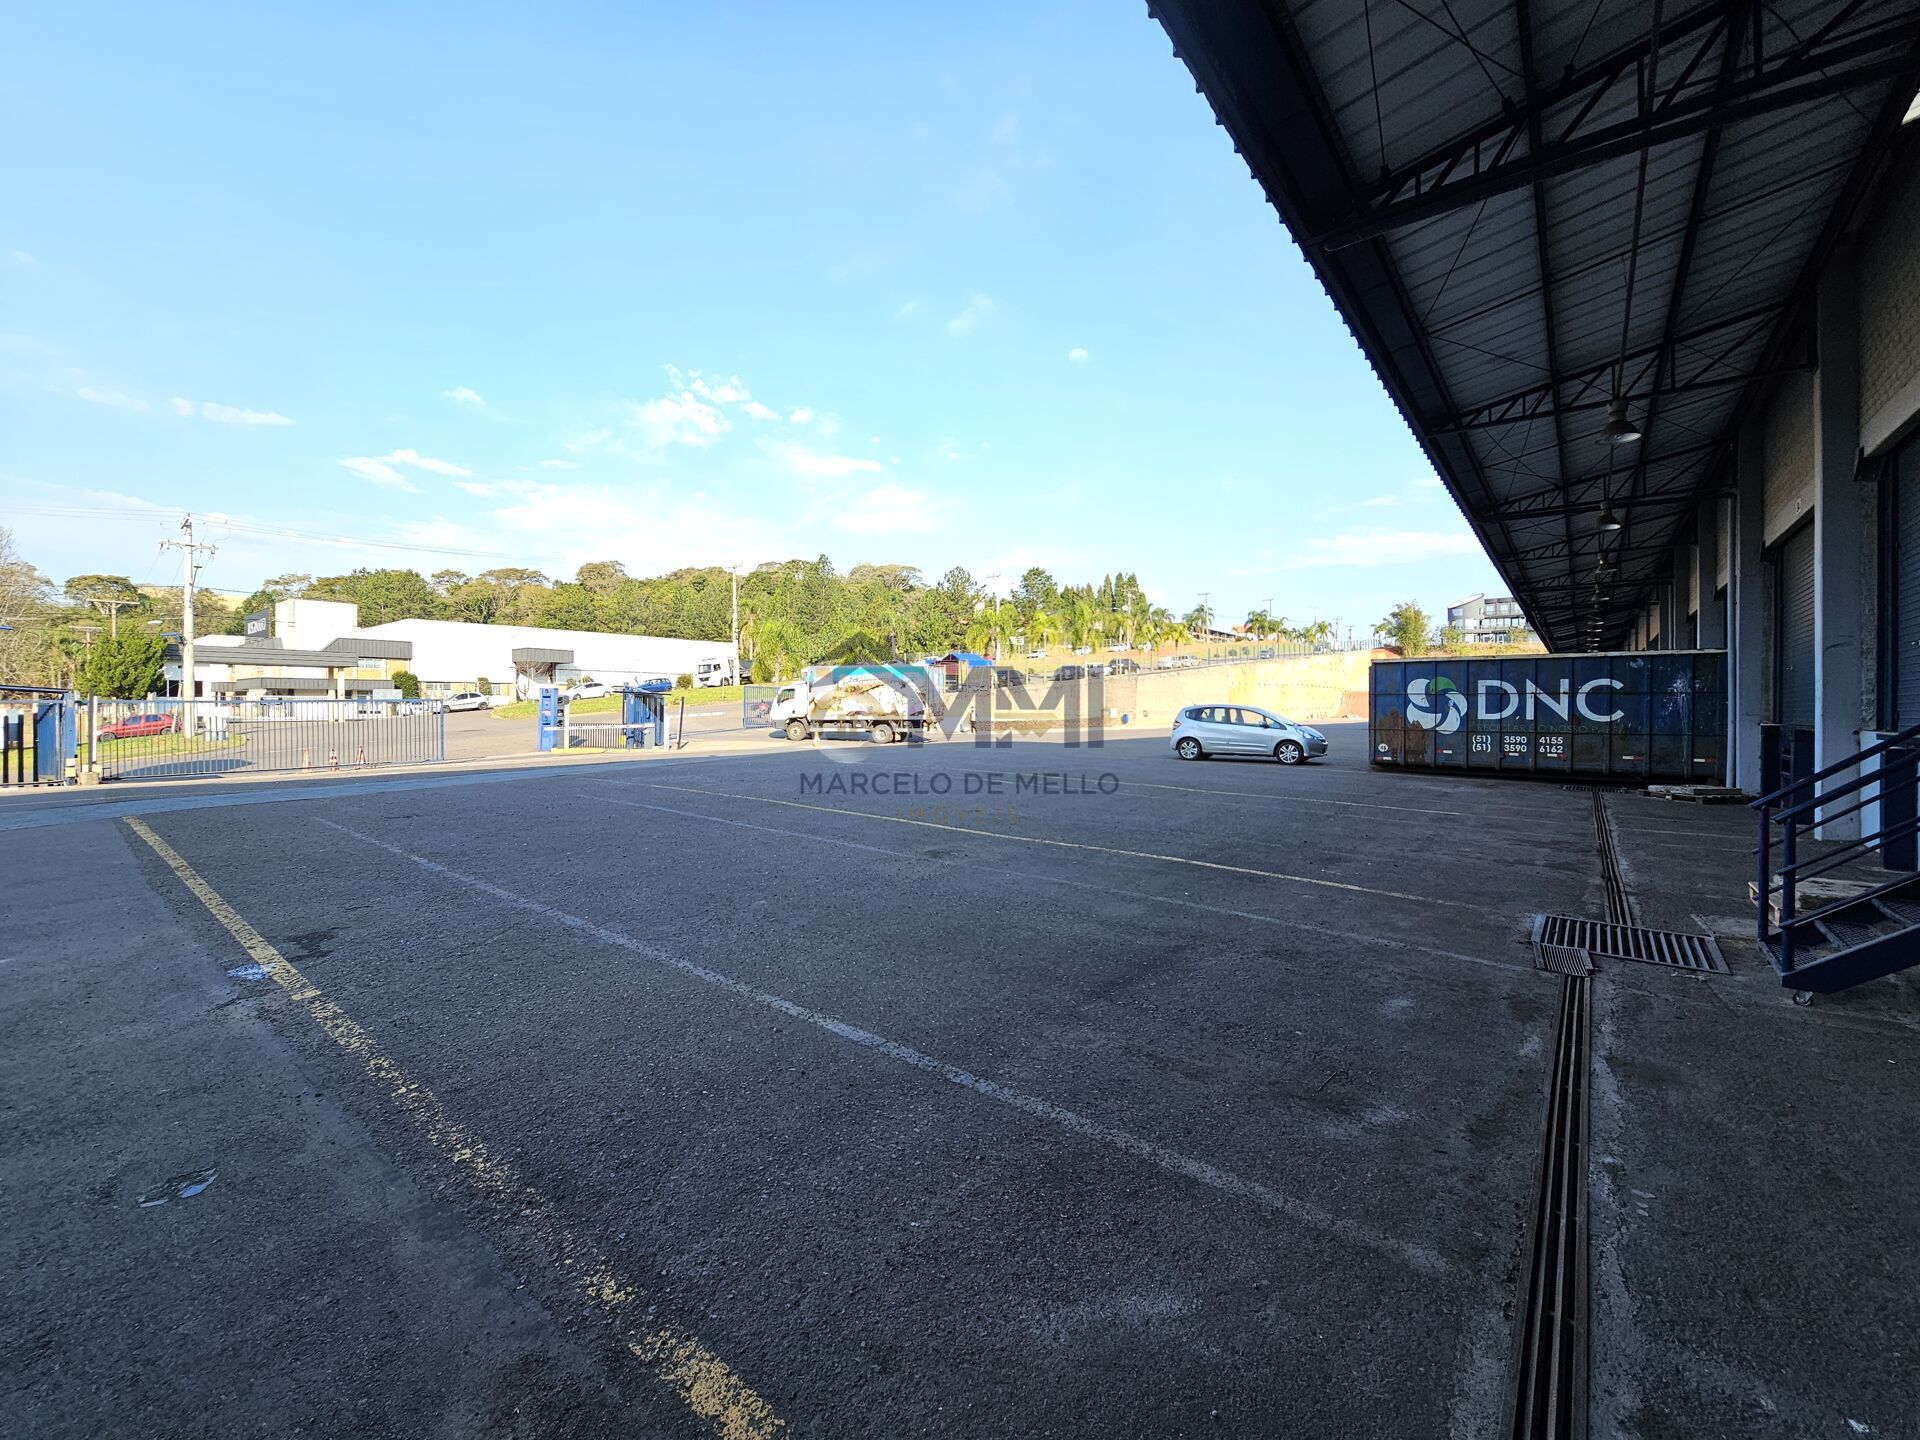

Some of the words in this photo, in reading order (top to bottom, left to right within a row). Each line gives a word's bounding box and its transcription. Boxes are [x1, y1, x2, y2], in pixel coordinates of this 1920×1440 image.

[1477, 678, 1625, 722] DNC
[1472, 735, 1491, 744] (51)
[1503, 735, 1527, 744] 3590
[1539, 736, 1564, 744] 4155
[1472, 743, 1491, 752] (51)
[1503, 744, 1527, 752] 3590
[1539, 745, 1564, 753] 6162
